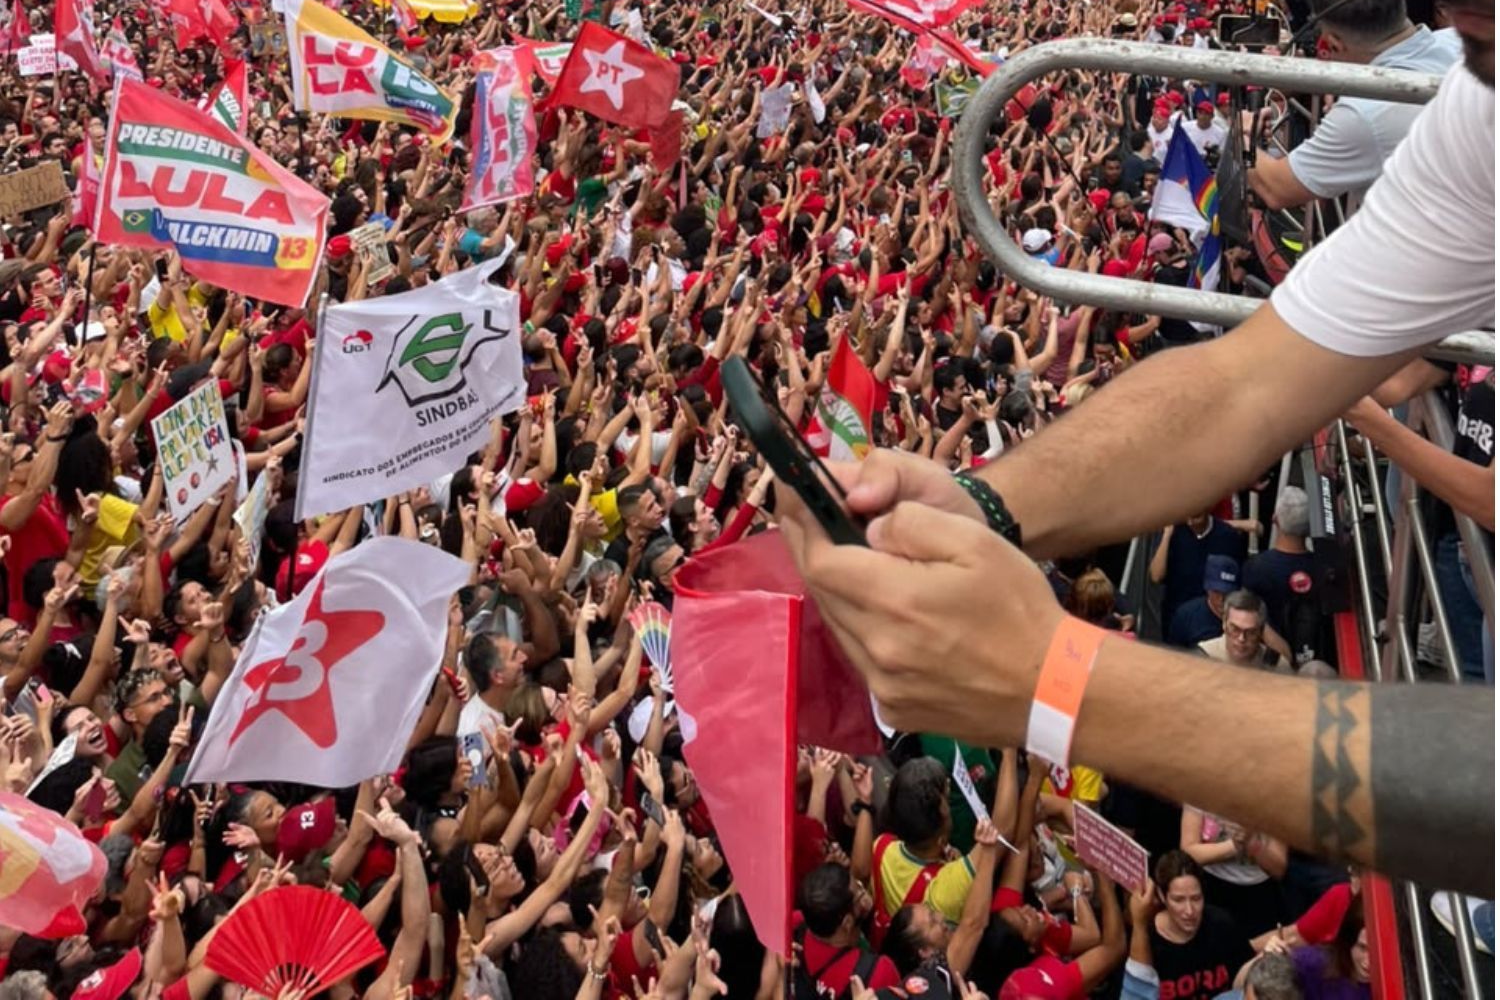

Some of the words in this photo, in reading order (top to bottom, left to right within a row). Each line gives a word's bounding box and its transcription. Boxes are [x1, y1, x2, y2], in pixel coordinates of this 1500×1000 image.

[303, 35, 378, 67] LU
[305, 65, 375, 96] LA
[596, 60, 624, 85] PT
[117, 122, 243, 165] PRESIDENTE
[118, 159, 296, 226] LULA
[168, 221, 272, 254] ALCKMIN
[280, 237, 308, 260] 13
[341, 342, 373, 354] UGT
[203, 424, 225, 451] USA
[323, 466, 375, 484] SINDICATO
[377, 459, 395, 472] DOS
[396, 433, 454, 463] EMPREGADOS
[385, 467, 396, 478] DE
[399, 444, 447, 472] ALIMENTOS
[300, 811, 315, 830] 13
